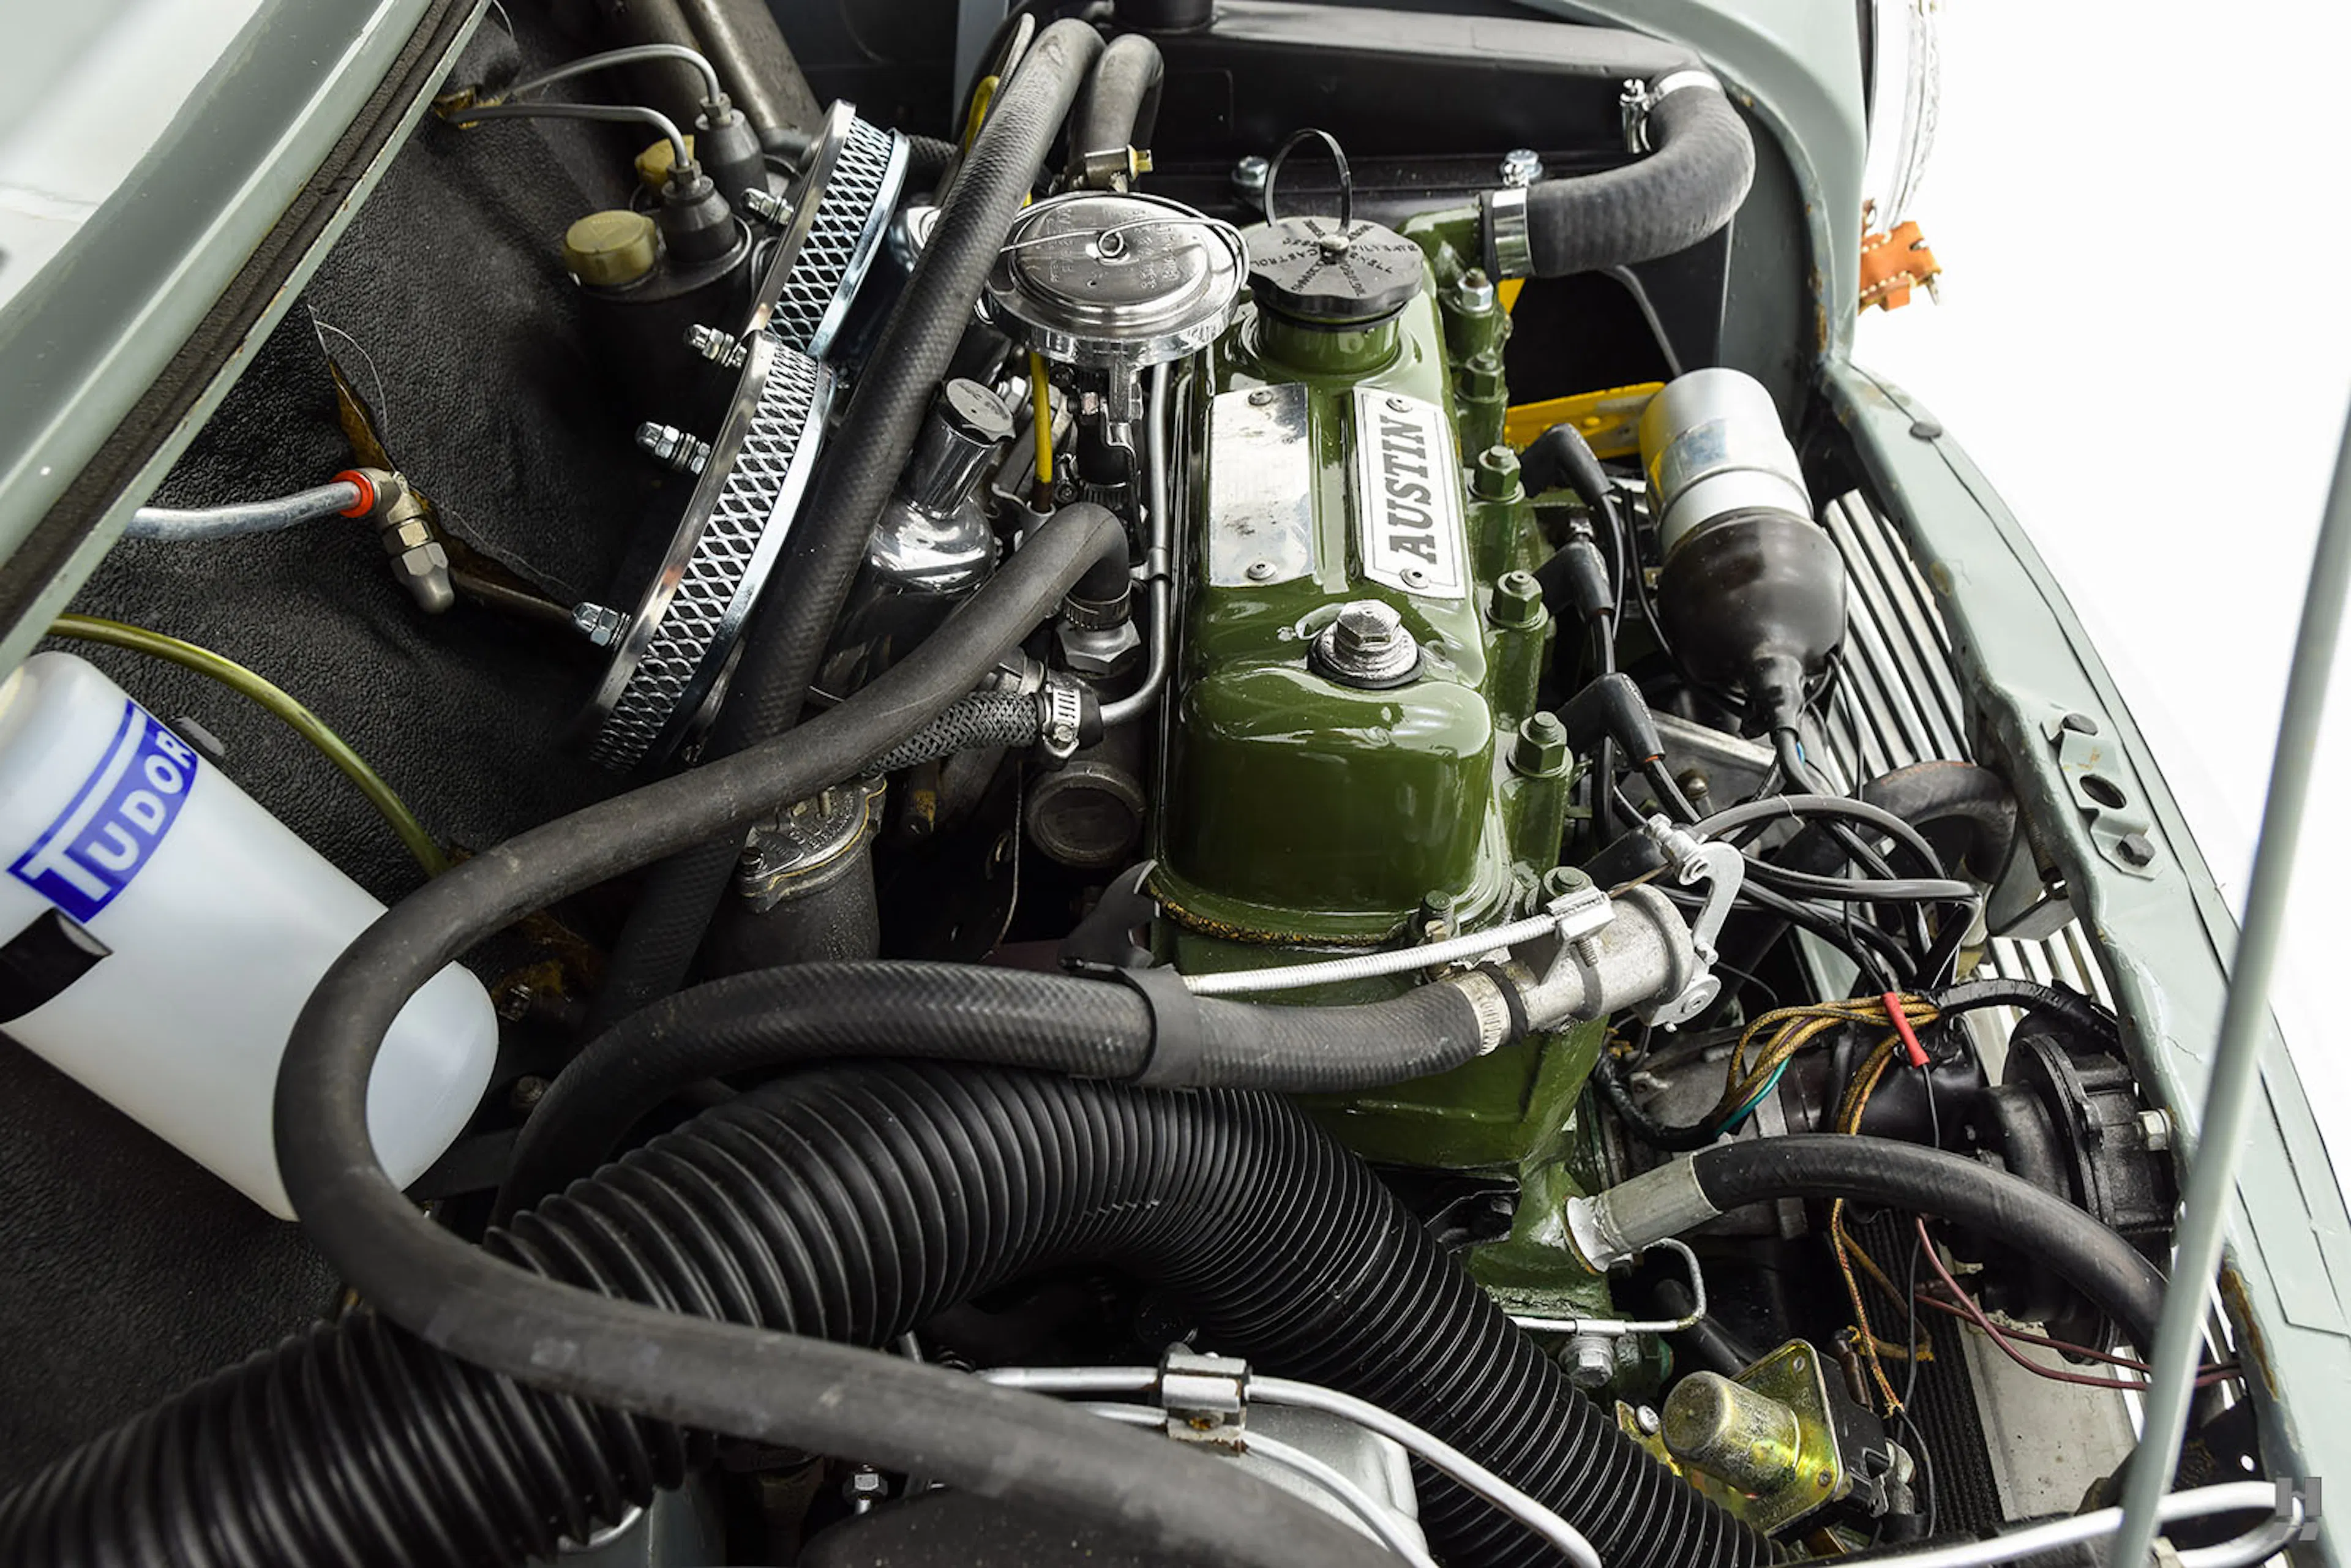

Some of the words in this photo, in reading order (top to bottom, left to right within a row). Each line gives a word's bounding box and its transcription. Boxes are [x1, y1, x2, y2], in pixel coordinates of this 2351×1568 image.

[1250, 247, 1318, 267] CASTROL
[1380, 415, 1437, 564] AUSTIN
[21, 707, 193, 902] TUDOR
